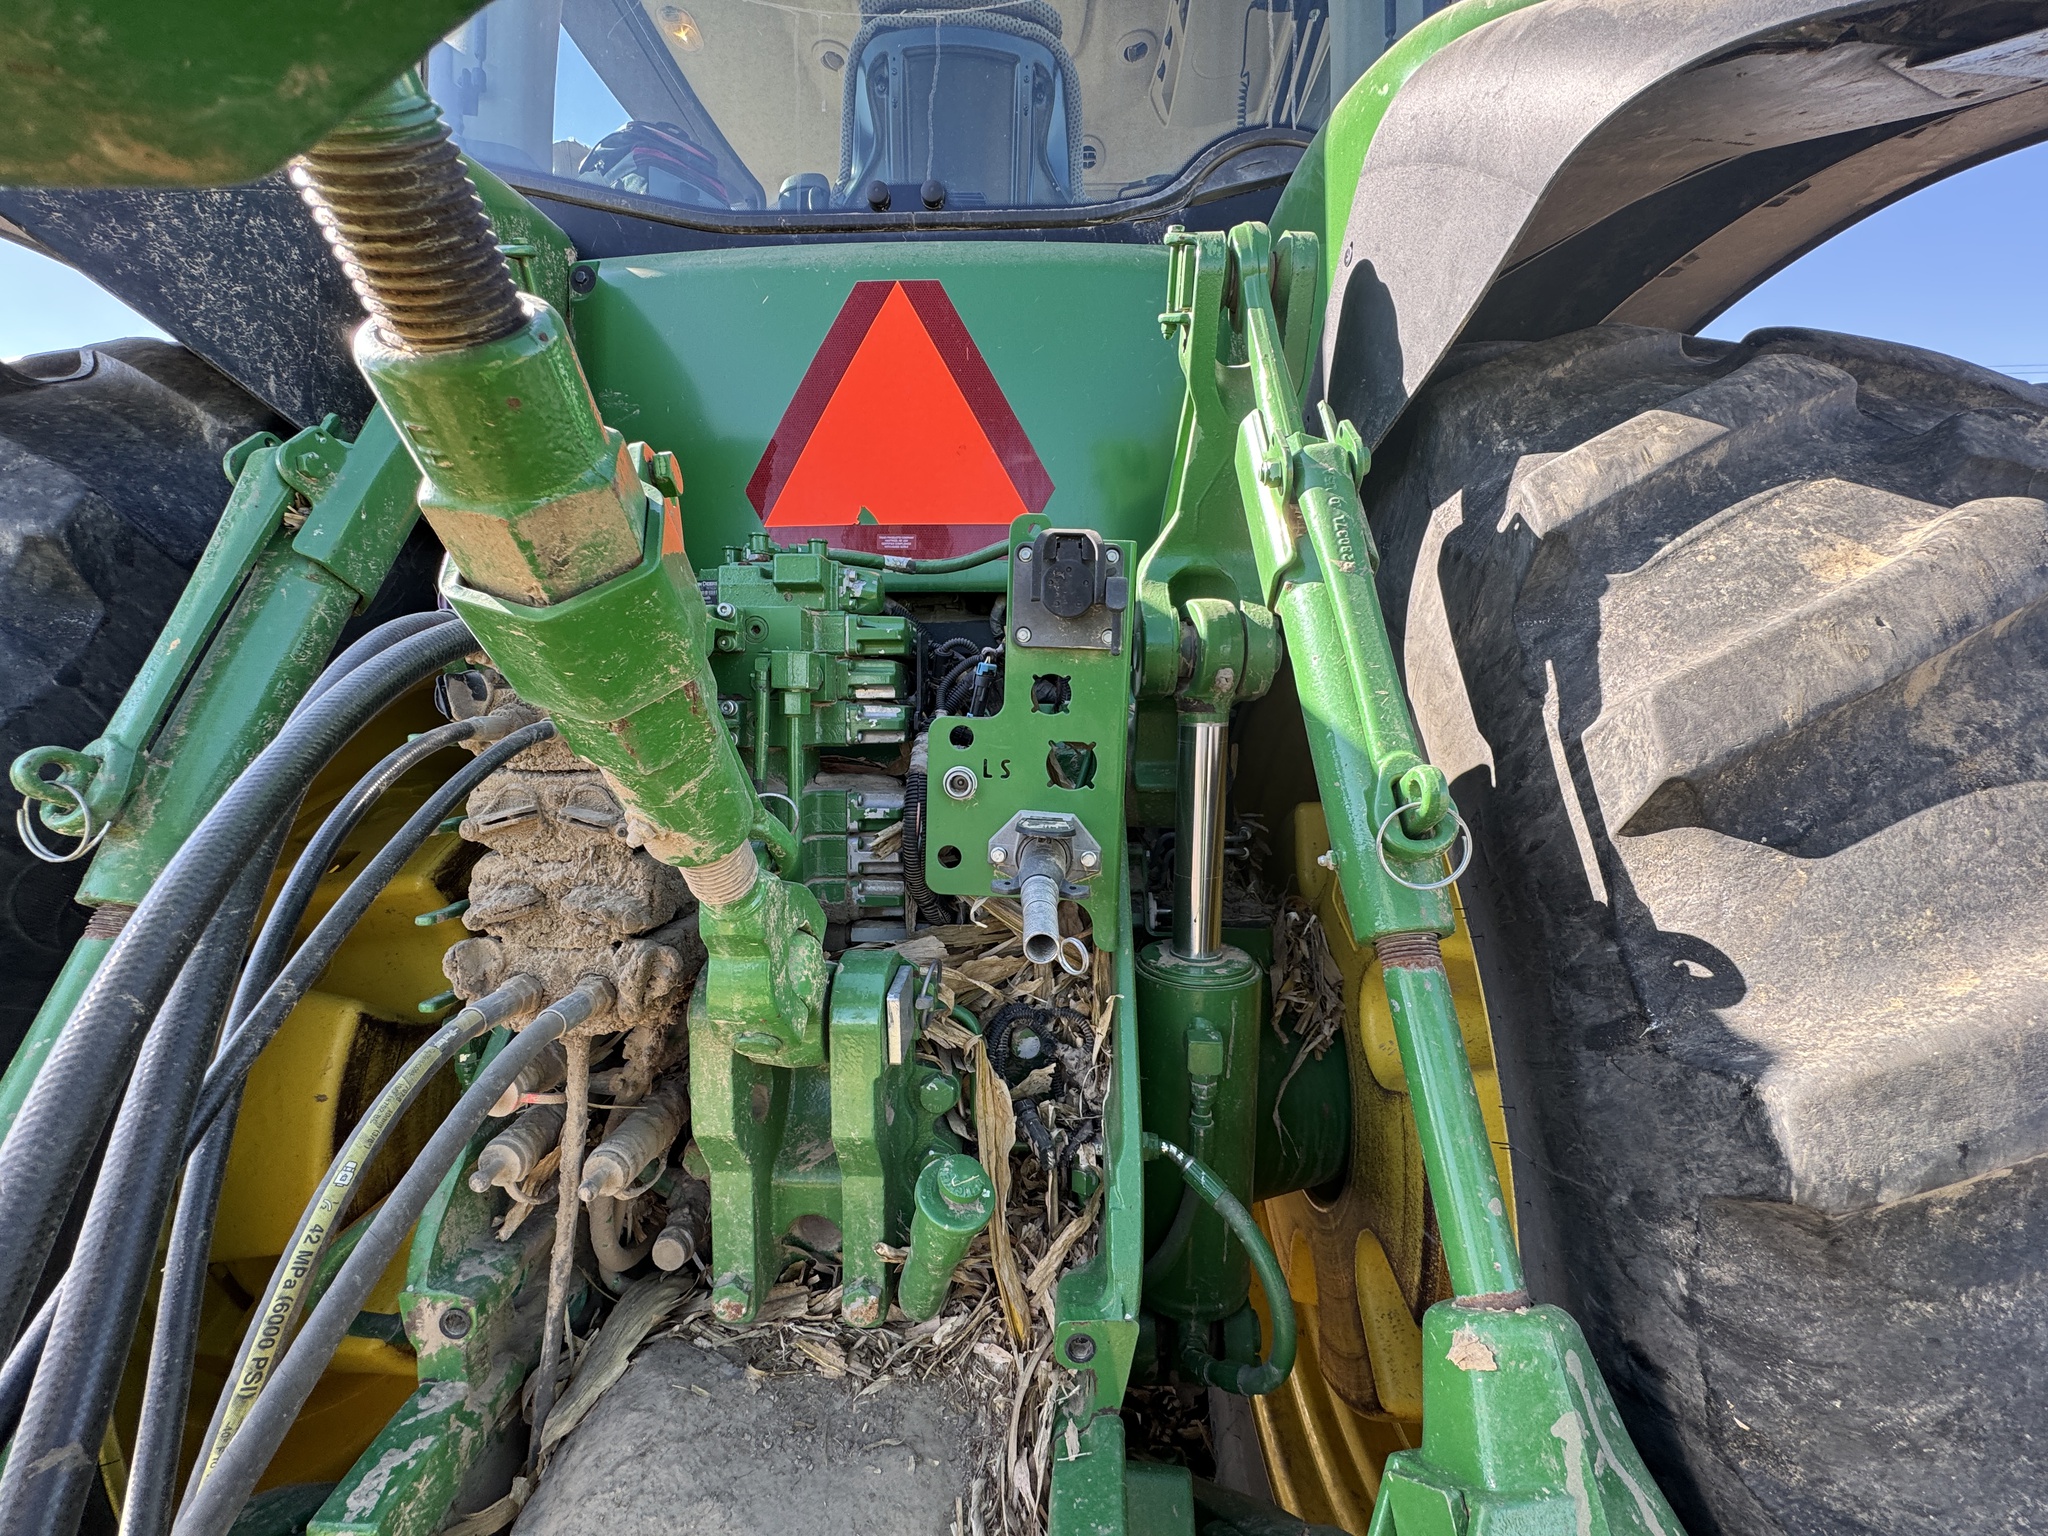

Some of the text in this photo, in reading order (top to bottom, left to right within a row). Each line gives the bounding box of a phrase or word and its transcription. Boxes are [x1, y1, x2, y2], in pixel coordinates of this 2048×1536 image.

[237, 1223, 324, 1401] 42 MPa (6000 PSI)
